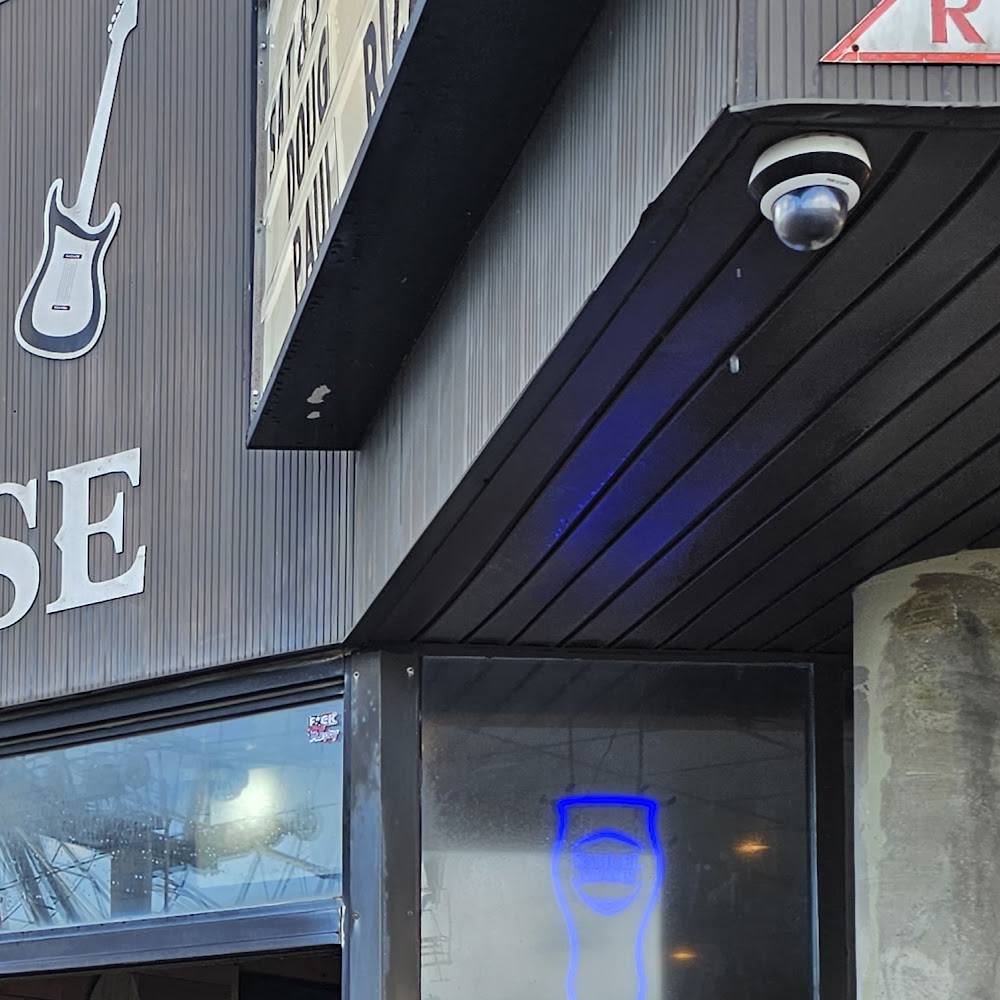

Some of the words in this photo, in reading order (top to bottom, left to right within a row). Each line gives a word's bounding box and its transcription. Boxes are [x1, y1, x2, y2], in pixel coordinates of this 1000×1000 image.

[931, 0, 986, 44] R
[286, 25, 330, 223] DOUG
[293, 141, 338, 312] PAUL
